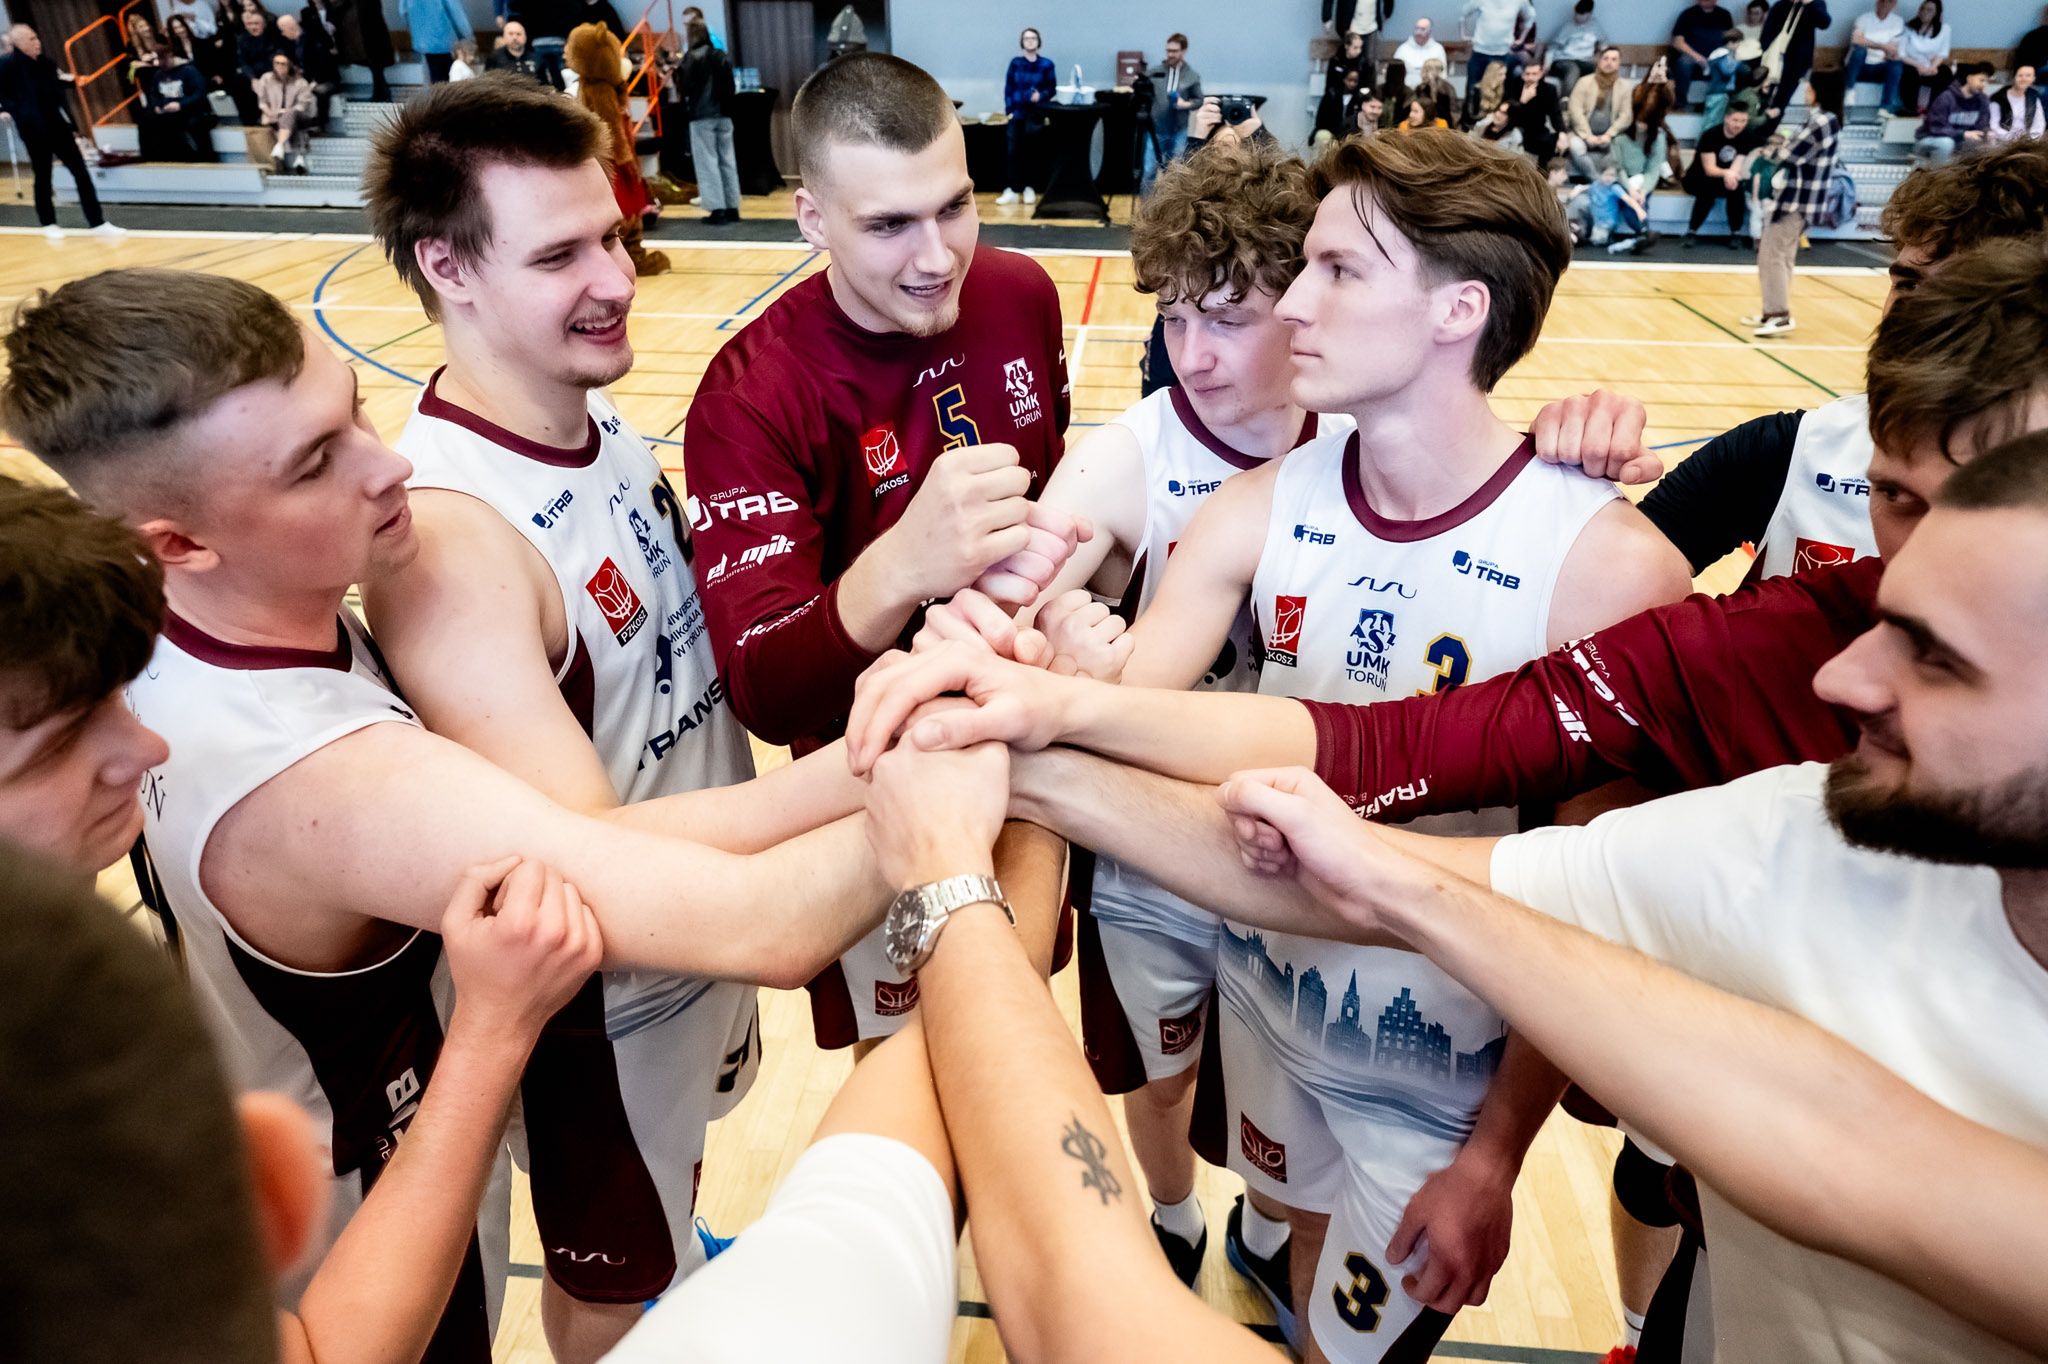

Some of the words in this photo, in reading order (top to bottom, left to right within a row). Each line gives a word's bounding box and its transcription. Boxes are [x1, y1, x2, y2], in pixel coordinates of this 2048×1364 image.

[932, 383, 982, 452] 5
[1009, 392, 1040, 417] UMK
[710, 486, 748, 501] GRUPA
[874, 473, 909, 497] PZKOSZ
[1840, 482, 1871, 496] TR
[547, 489, 574, 519] TRB
[710, 491, 799, 521] TRB
[1302, 529, 1336, 545] TRB
[644, 540, 665, 567] MK
[1476, 565, 1521, 590] TRB
[620, 609, 648, 643] PZKOSZ
[1265, 650, 1294, 666] KOSZ
[1346, 650, 1390, 678] UMK
[1416, 632, 1473, 697] 3
[1332, 1251, 1391, 1333] 3
